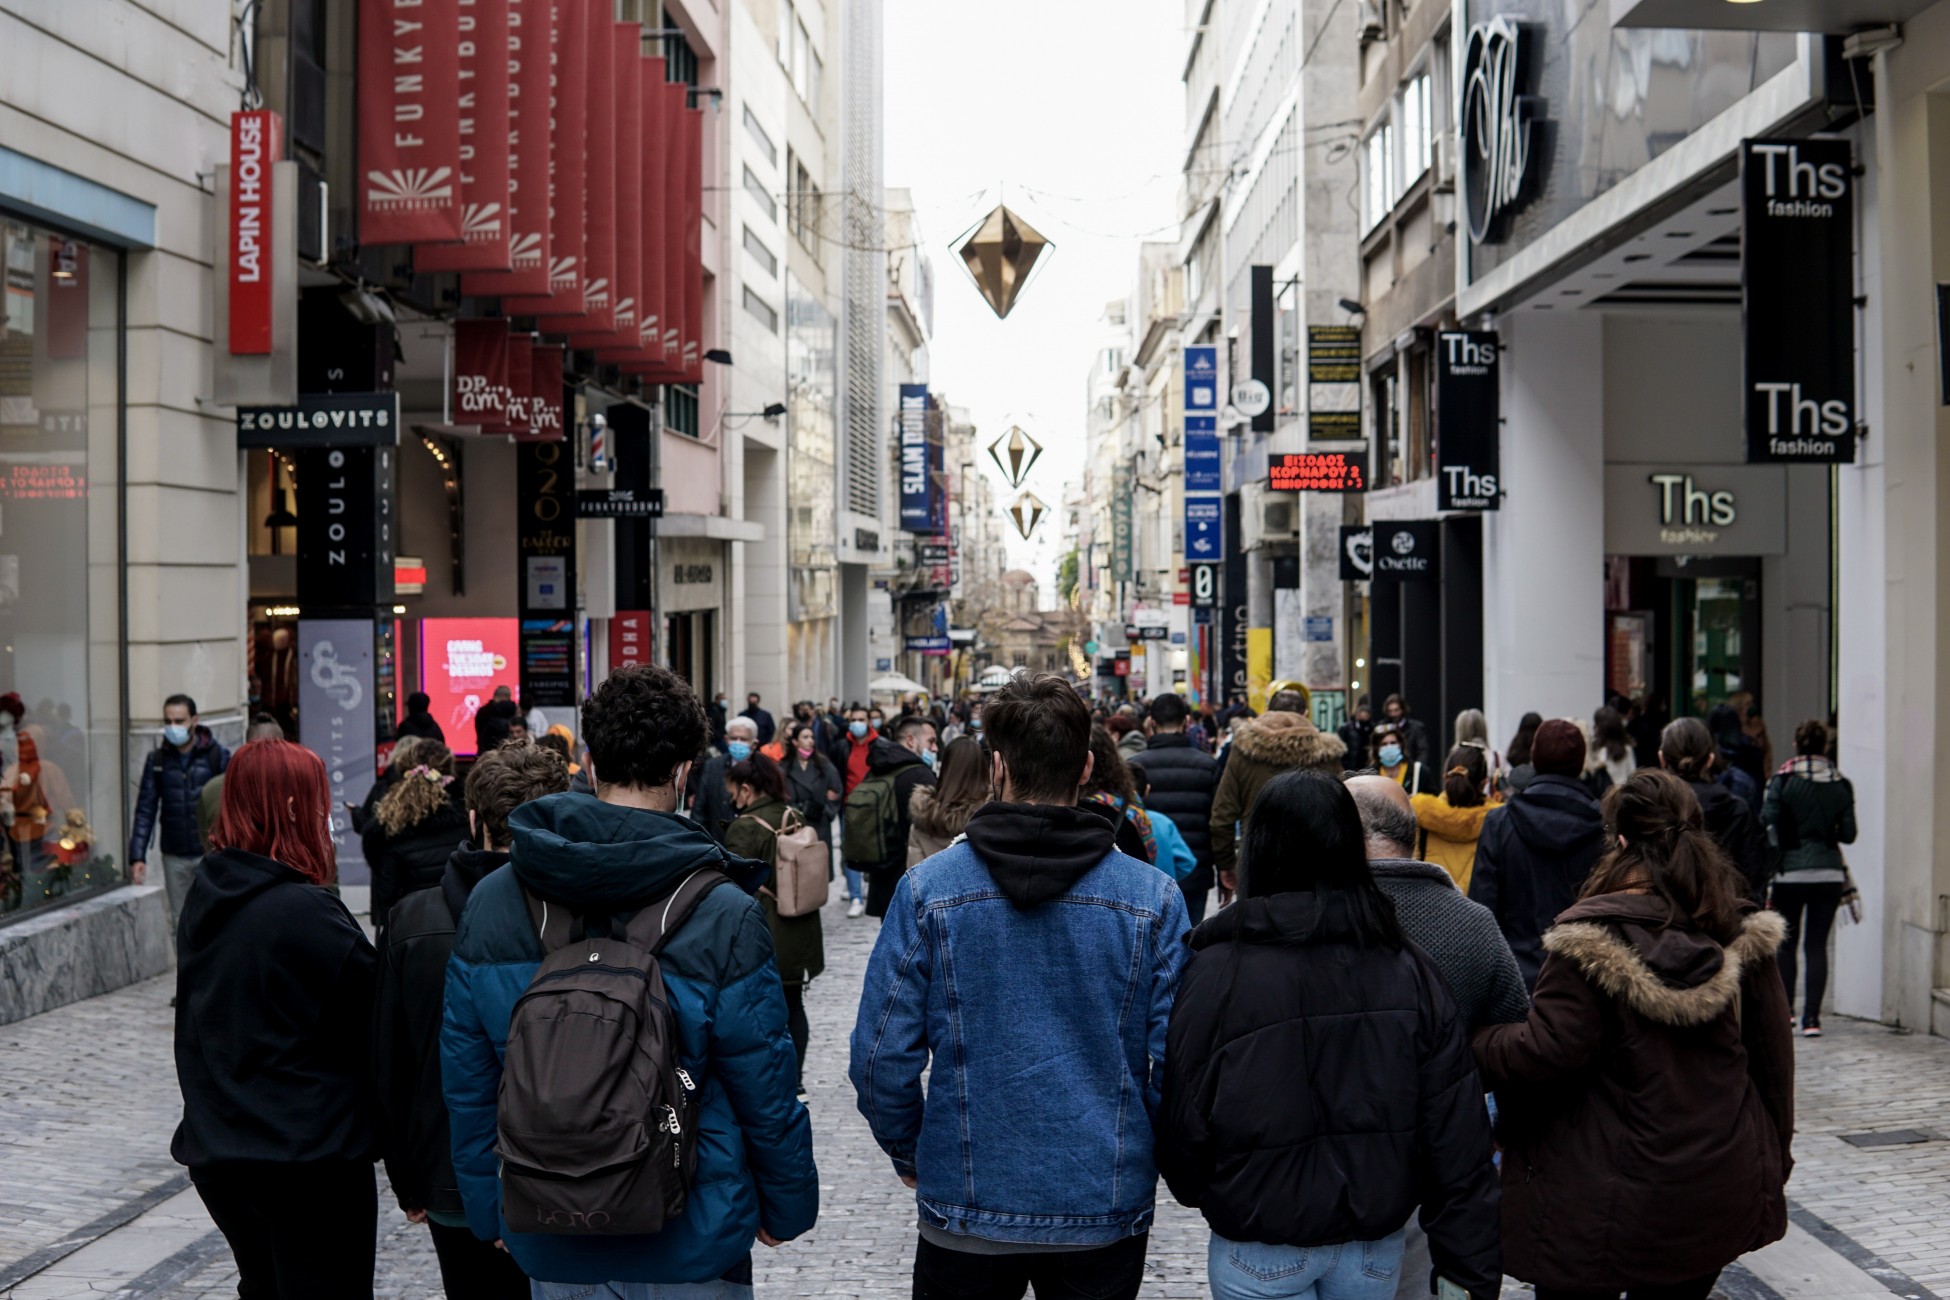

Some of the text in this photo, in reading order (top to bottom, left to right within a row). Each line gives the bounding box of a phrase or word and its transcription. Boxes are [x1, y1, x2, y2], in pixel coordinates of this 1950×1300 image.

[1752, 145, 1845, 197] Ths
[239, 117, 261, 282] LAPIN HOUSE
[1768, 200, 1832, 217] fashion
[1442, 333, 1496, 364] Ths
[1450, 365, 1488, 376] fashion
[462, 392, 503, 411] am
[1755, 383, 1848, 435] Ths
[241, 409, 389, 430] ZOULOVITS
[1769, 438, 1835, 455] fashion
[902, 446, 925, 494] SLAM
[1270, 466, 1359, 478] ΚΟΡΝΑΡΟΥ 2
[1283, 454, 1345, 467] ΕΙΣΟΔΟΣ
[1443, 466, 1497, 497] Ths
[1451, 498, 1489, 508] fashion
[1651, 474, 1736, 525] Ths
[332, 716, 345, 845] ZOULOVITS
